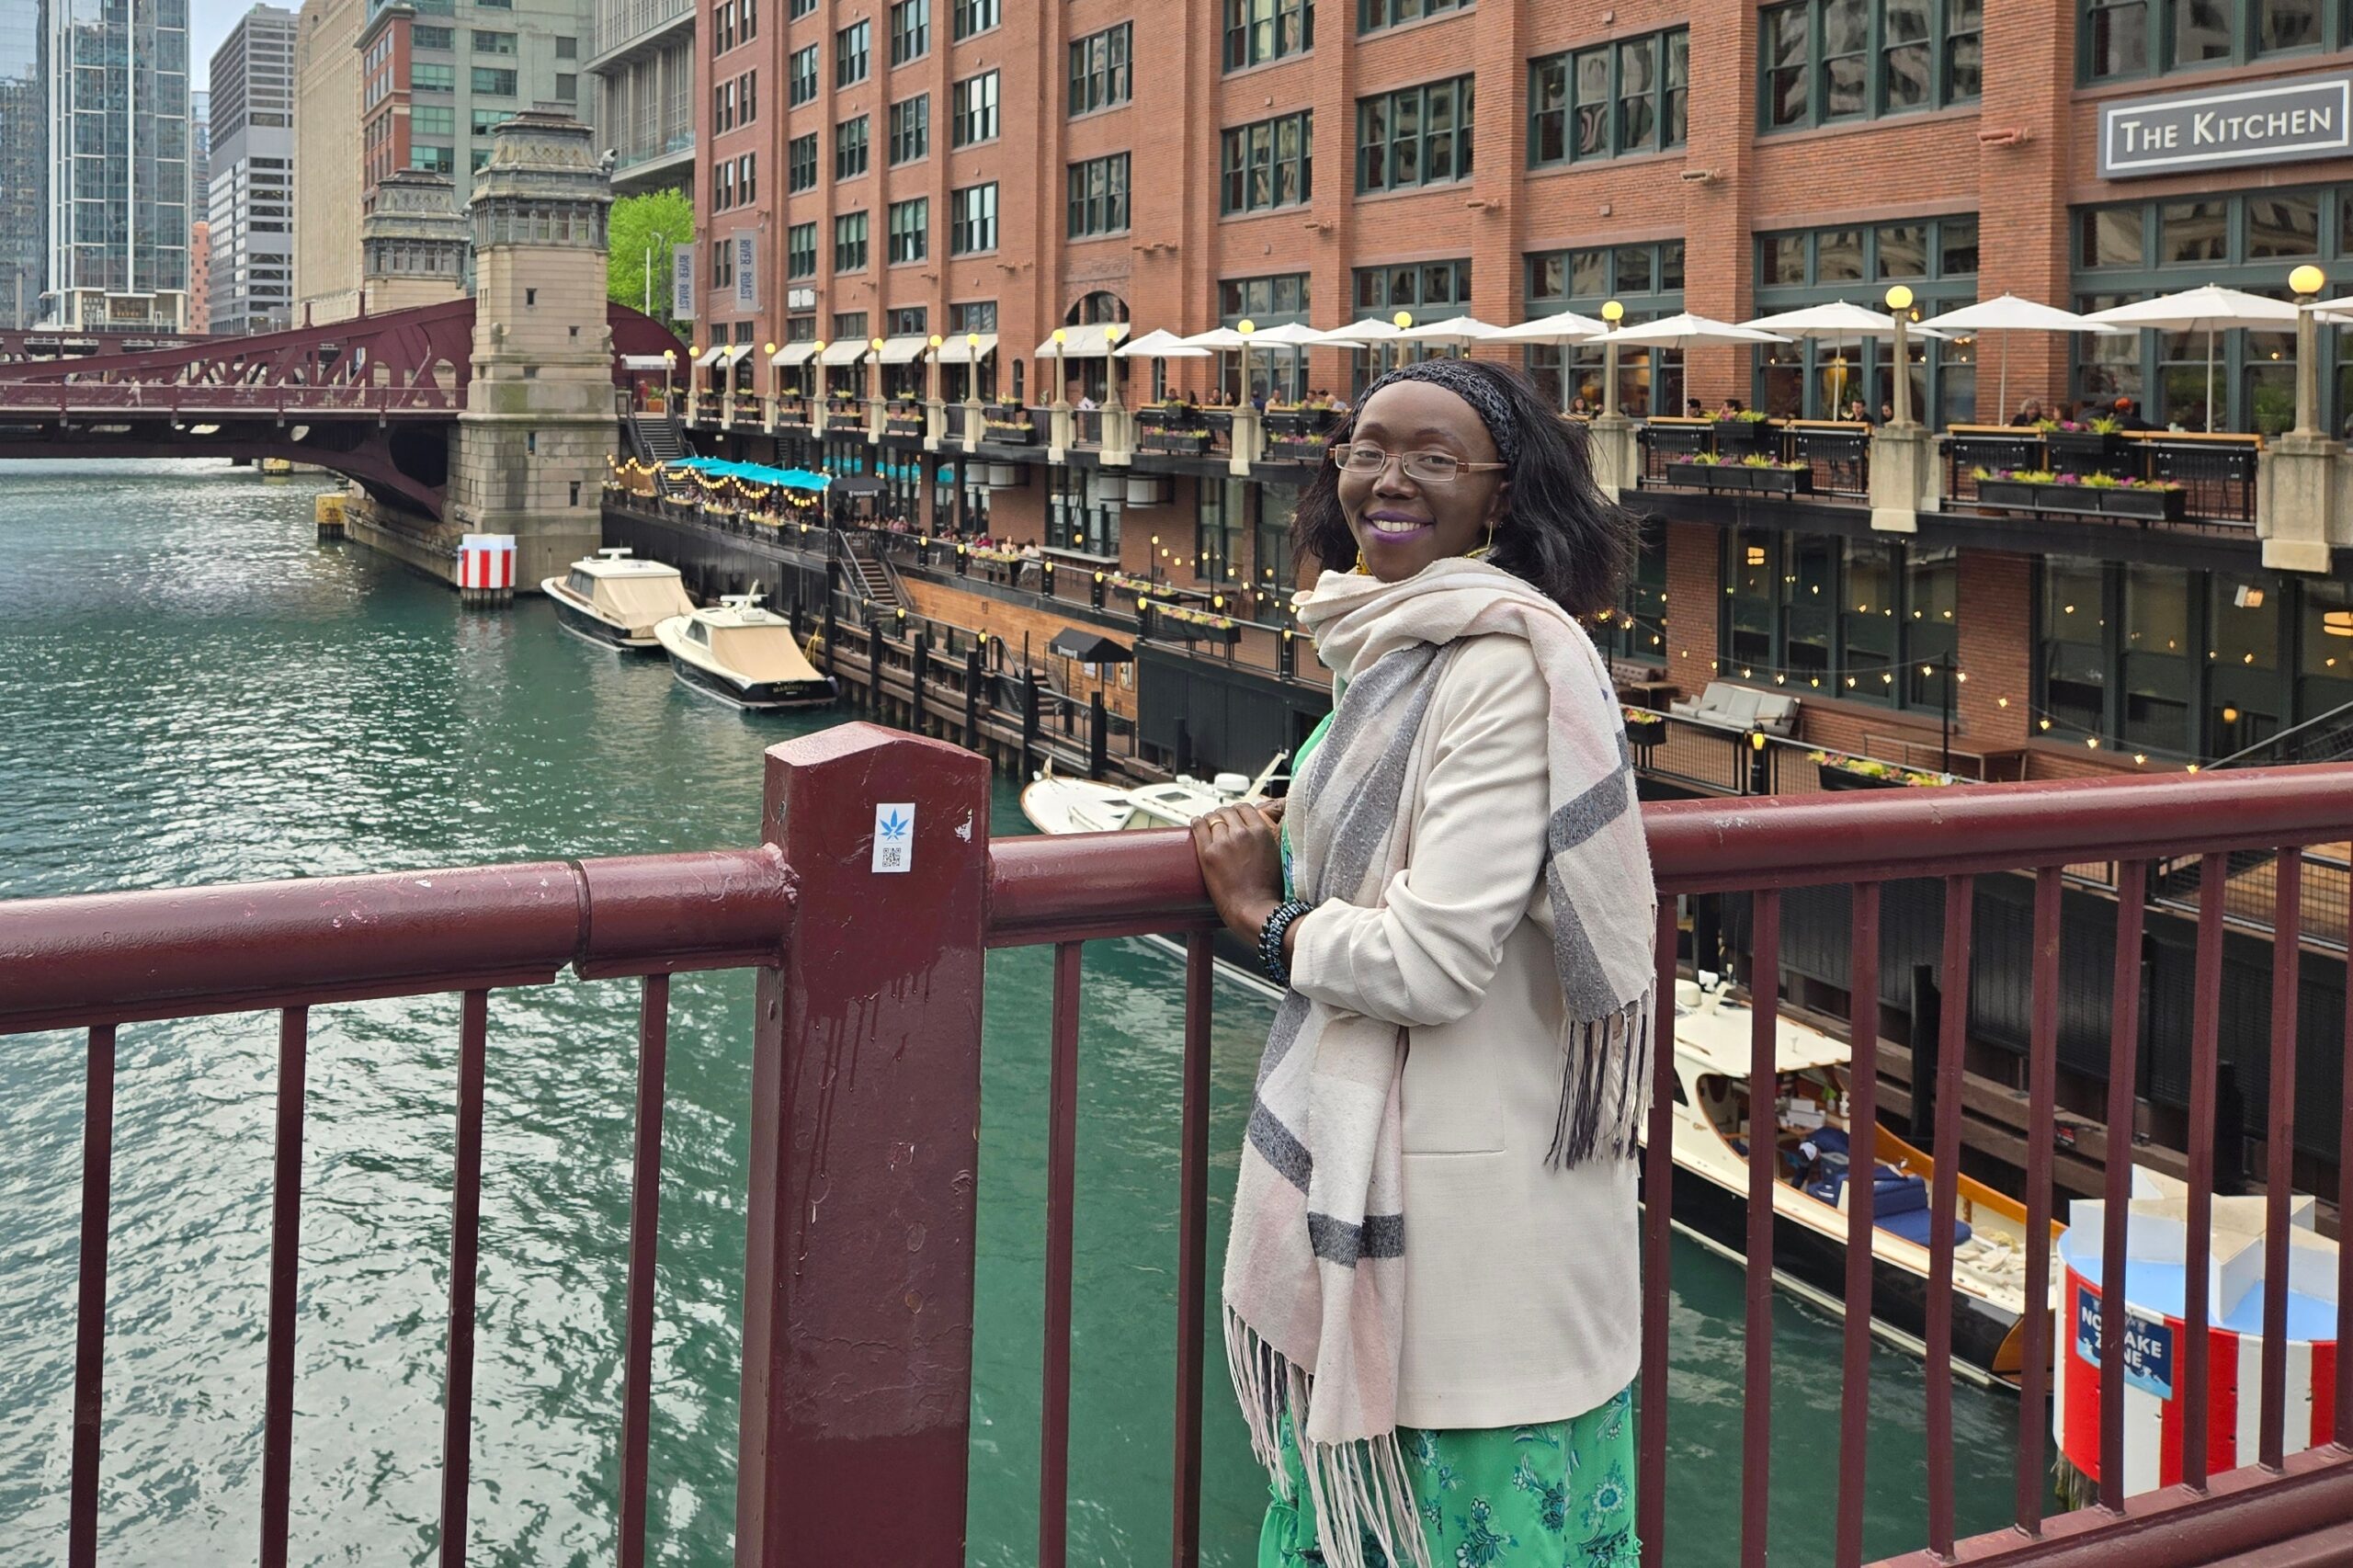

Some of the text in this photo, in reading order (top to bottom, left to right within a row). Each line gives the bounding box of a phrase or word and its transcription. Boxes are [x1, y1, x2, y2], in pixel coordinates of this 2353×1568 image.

[2120, 107, 2331, 153] THE KITCHEN
[678, 255, 689, 309] RIVER ROAST
[739, 239, 752, 301] RIVER ROAST
[2095, 1332, 2143, 1369] ZNE
[2123, 1331, 2162, 1358] AKE
